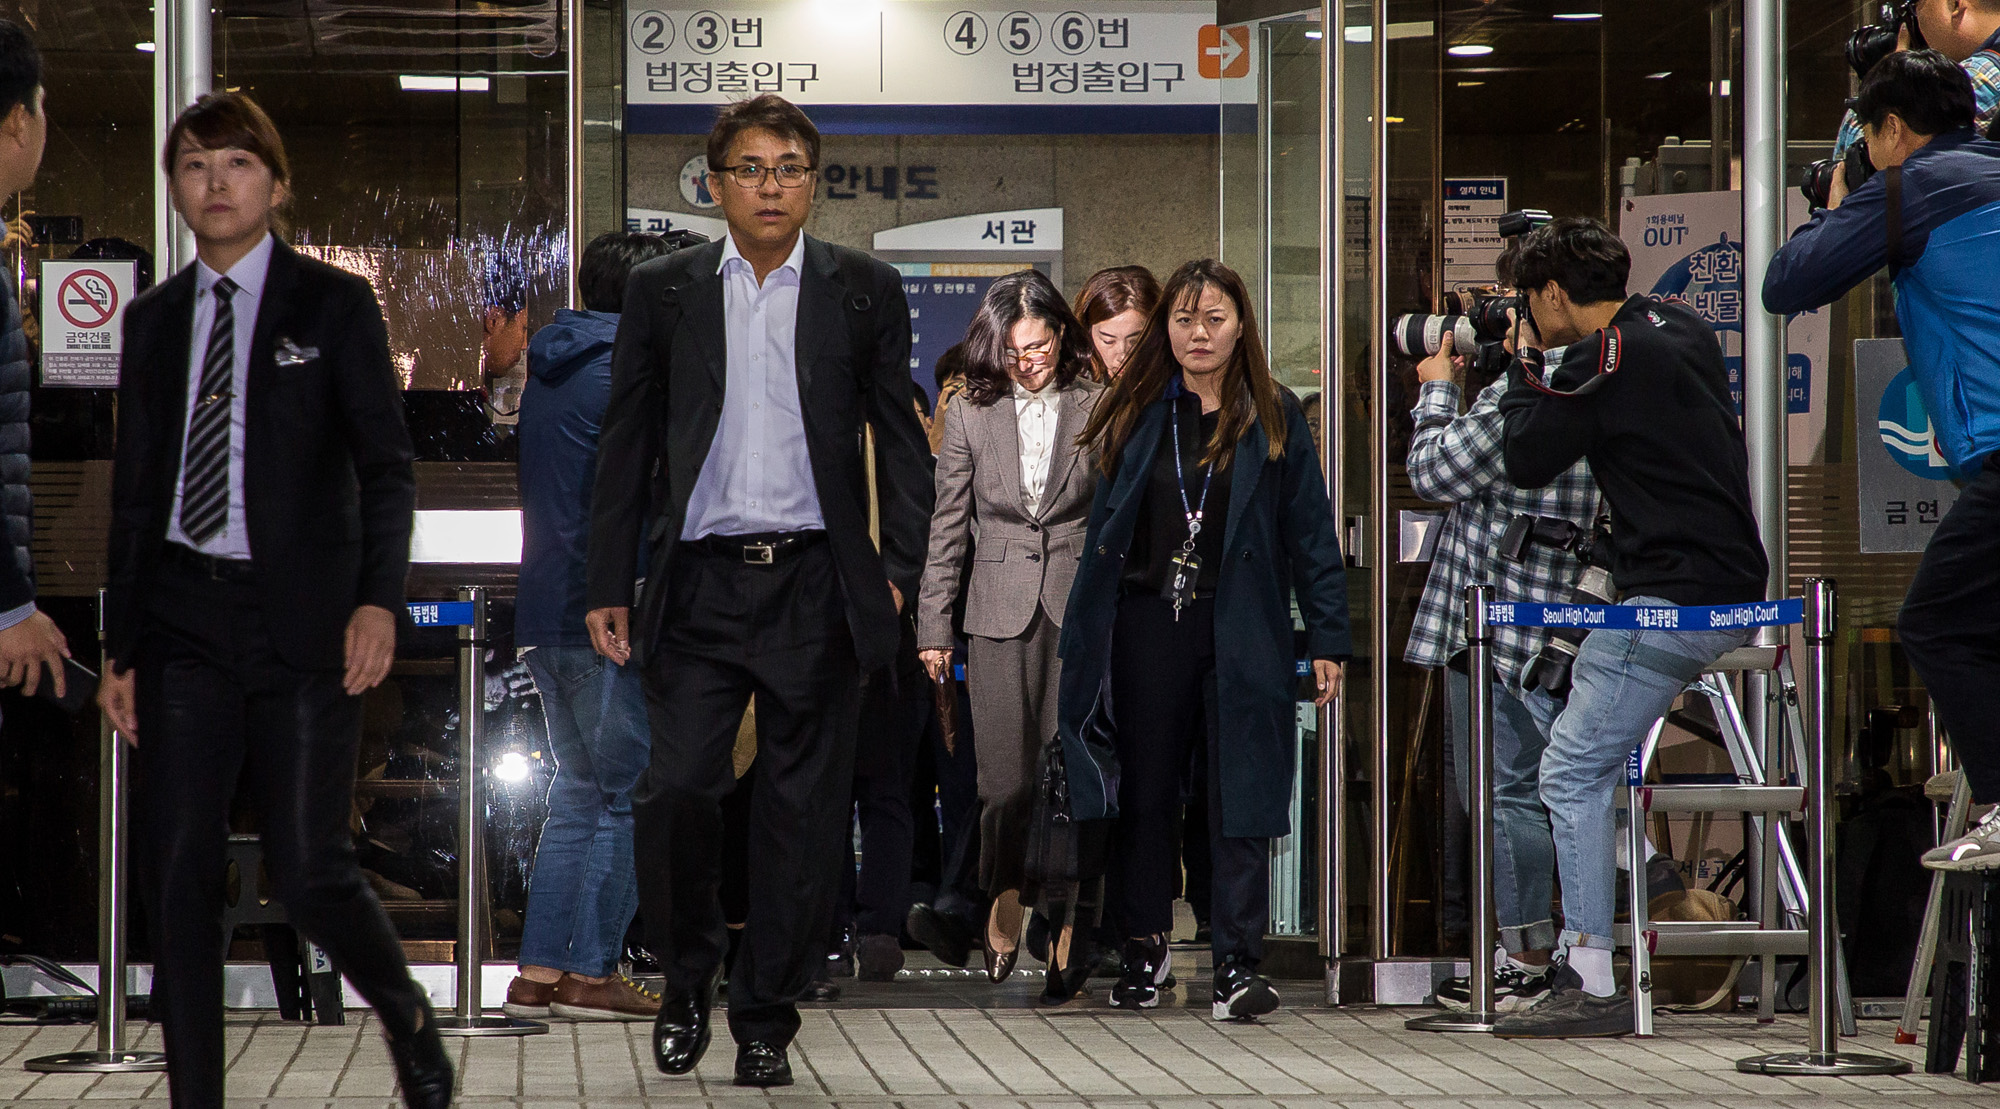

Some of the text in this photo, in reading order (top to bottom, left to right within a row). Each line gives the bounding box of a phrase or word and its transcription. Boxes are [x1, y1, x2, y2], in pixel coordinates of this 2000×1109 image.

[645, 61, 819, 93] 법정출입구
[1012, 61, 1185, 94] 법정출입구
[816, 163, 938, 200] 안내도
[1646, 213, 1685, 225] 1회용비닐
[981, 220, 1036, 244] 서관
[1643, 226, 1685, 247] OUT
[1689, 250, 1740, 284] 친환
[65, 331, 112, 343] 금연건물
[1605, 338, 1617, 373] Canon
[1487, 604, 1779, 628] 고등법원 Seoul High Court 서울고등법원 Seoul High Court
[1679, 859, 1726, 879] 서울고
